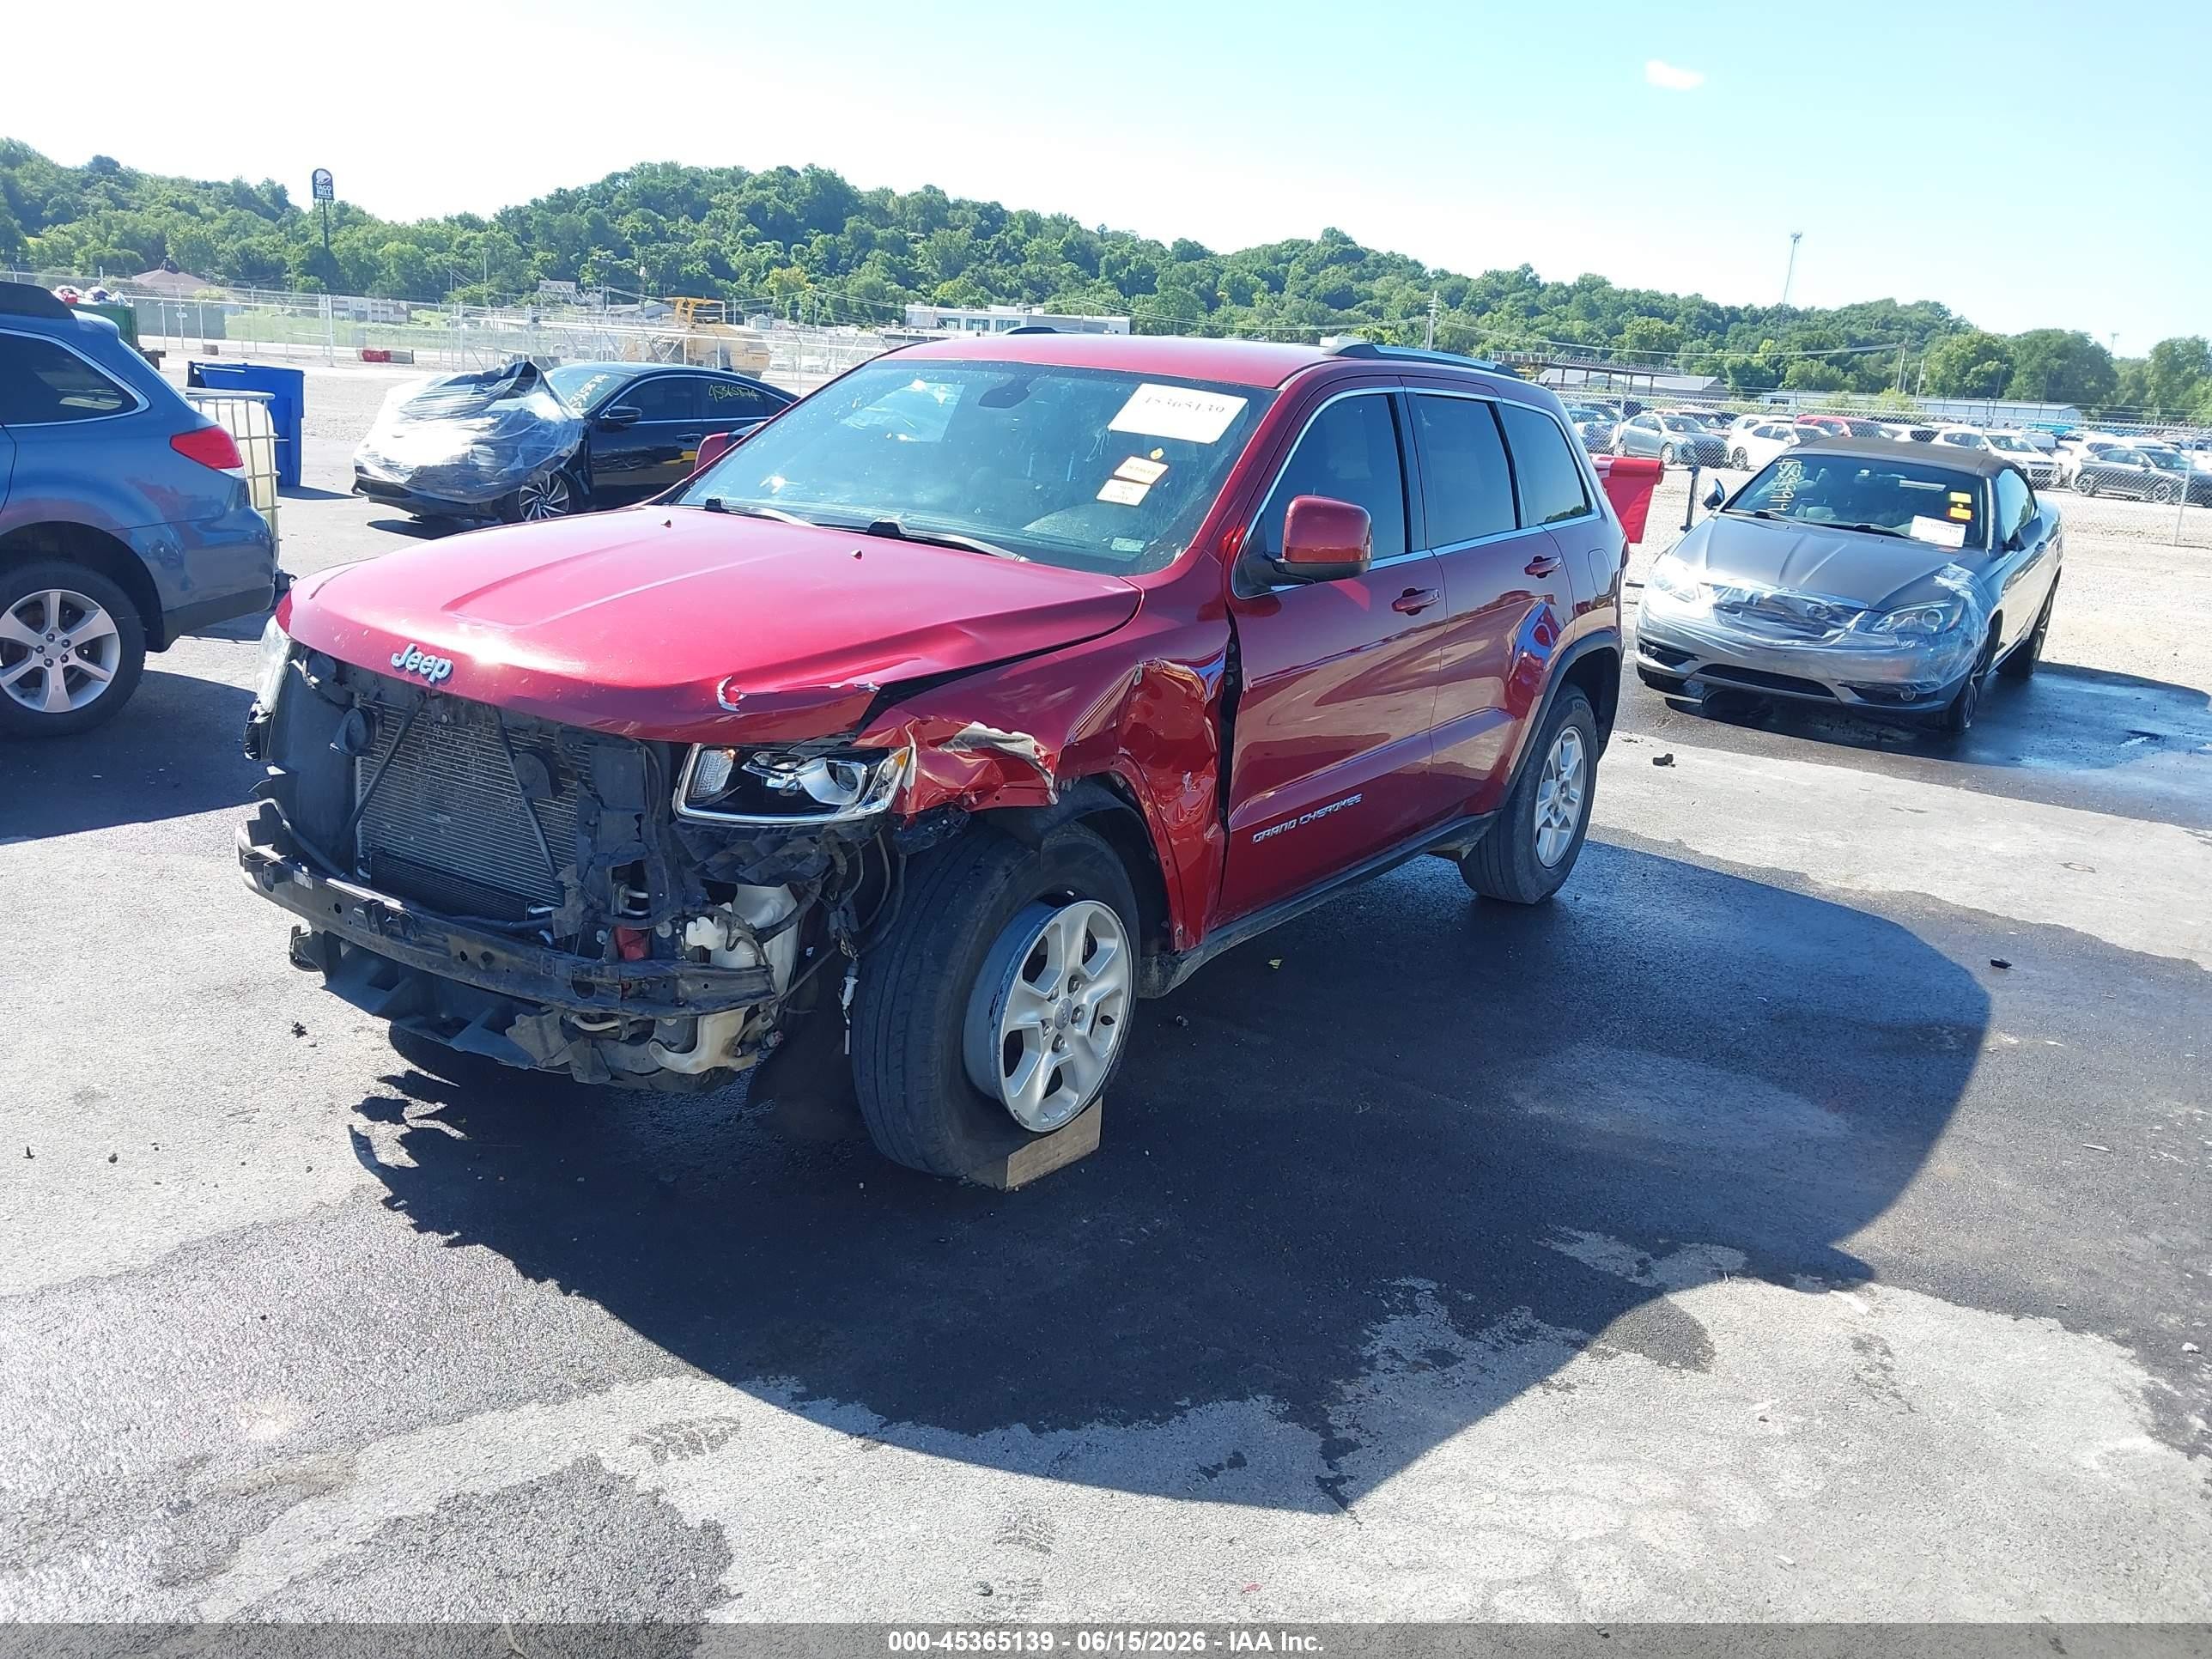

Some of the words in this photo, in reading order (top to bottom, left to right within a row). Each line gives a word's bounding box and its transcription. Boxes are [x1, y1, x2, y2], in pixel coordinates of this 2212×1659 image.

[391, 642, 454, 684] Jeep
[1252, 818, 1297, 844] GRAND
[1298, 793, 1363, 824] CHEROKEE
